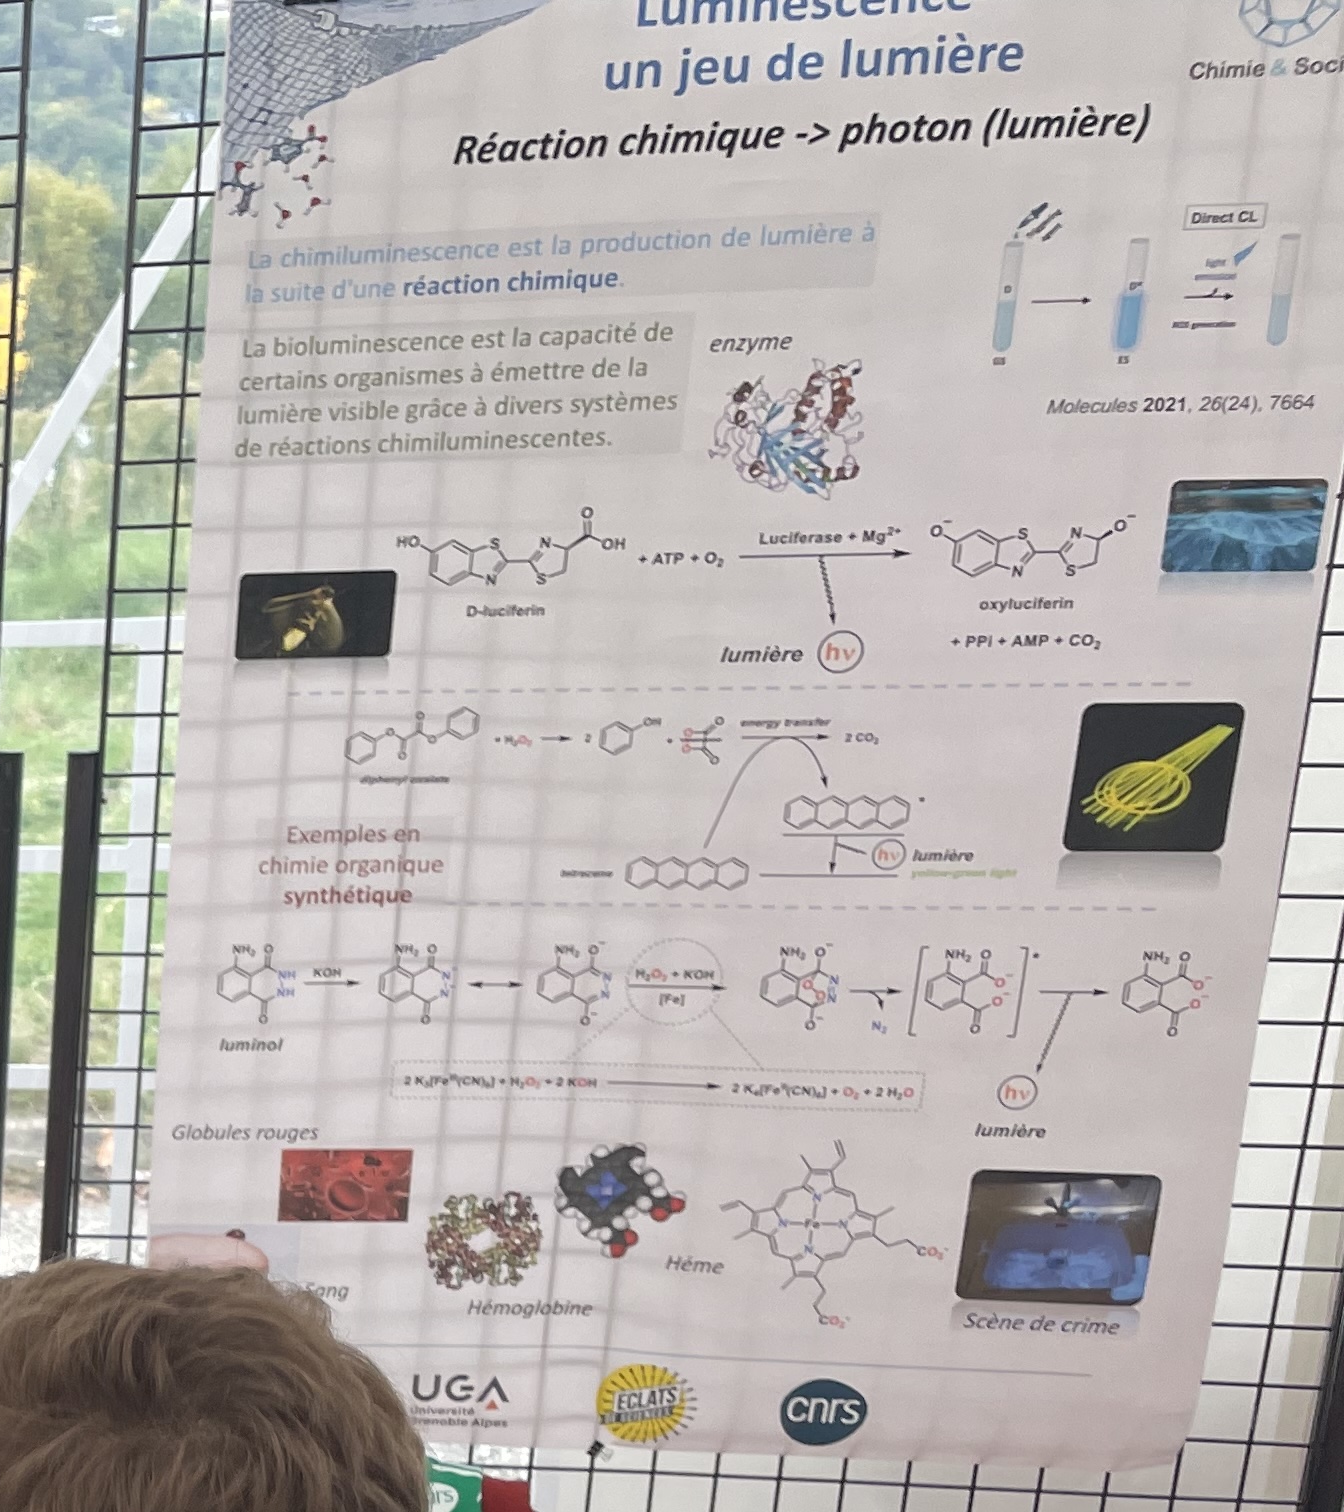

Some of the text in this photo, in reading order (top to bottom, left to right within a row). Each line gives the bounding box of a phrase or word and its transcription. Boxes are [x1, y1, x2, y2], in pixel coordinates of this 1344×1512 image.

[604, 33, 1025, 97] un jeu de lumière
[1188, 60, 1266, 81] Chimie
[453, 104, 1152, 165] Réaction chimique photon (lumière)
[1191, 209, 1259, 225] Direct CL
[248, 220, 876, 271] La chimiluminescence est la production de lumière à
[245, 284, 264, 304] la
[271, 284, 324, 302] suite
[403, 274, 500, 296] réaction
[506, 269, 624, 293] chimique.
[242, 321, 674, 359] La bioluminescence est la capacité de
[709, 332, 794, 357] enzyme
[238, 356, 648, 392] certains organismes à émettre de la
[237, 391, 678, 427] lumière visible grâce à divers systèmes
[1046, 398, 1138, 414] Molecules
[1270, 393, 1315, 410] 7664
[234, 427, 613, 460] de réactions chimiluminescentes.
[979, 596, 1074, 613] oxyluciferin
[720, 645, 803, 663] lumière
[285, 825, 421, 849] Exemples en
[912, 848, 974, 862] lumière
[258, 855, 445, 881] chimie organique
[283, 884, 412, 910] synthétique
[219, 1037, 284, 1051] luminol
[171, 1123, 319, 1144] Globules rouges
[974, 1123, 1046, 1138] lumière
[467, 1299, 595, 1320] Hémoglobine
[962, 1311, 1120, 1335] Scène de crime
[411, 1374, 510, 1404] UGA
[786, 1395, 862, 1426] cnrs
